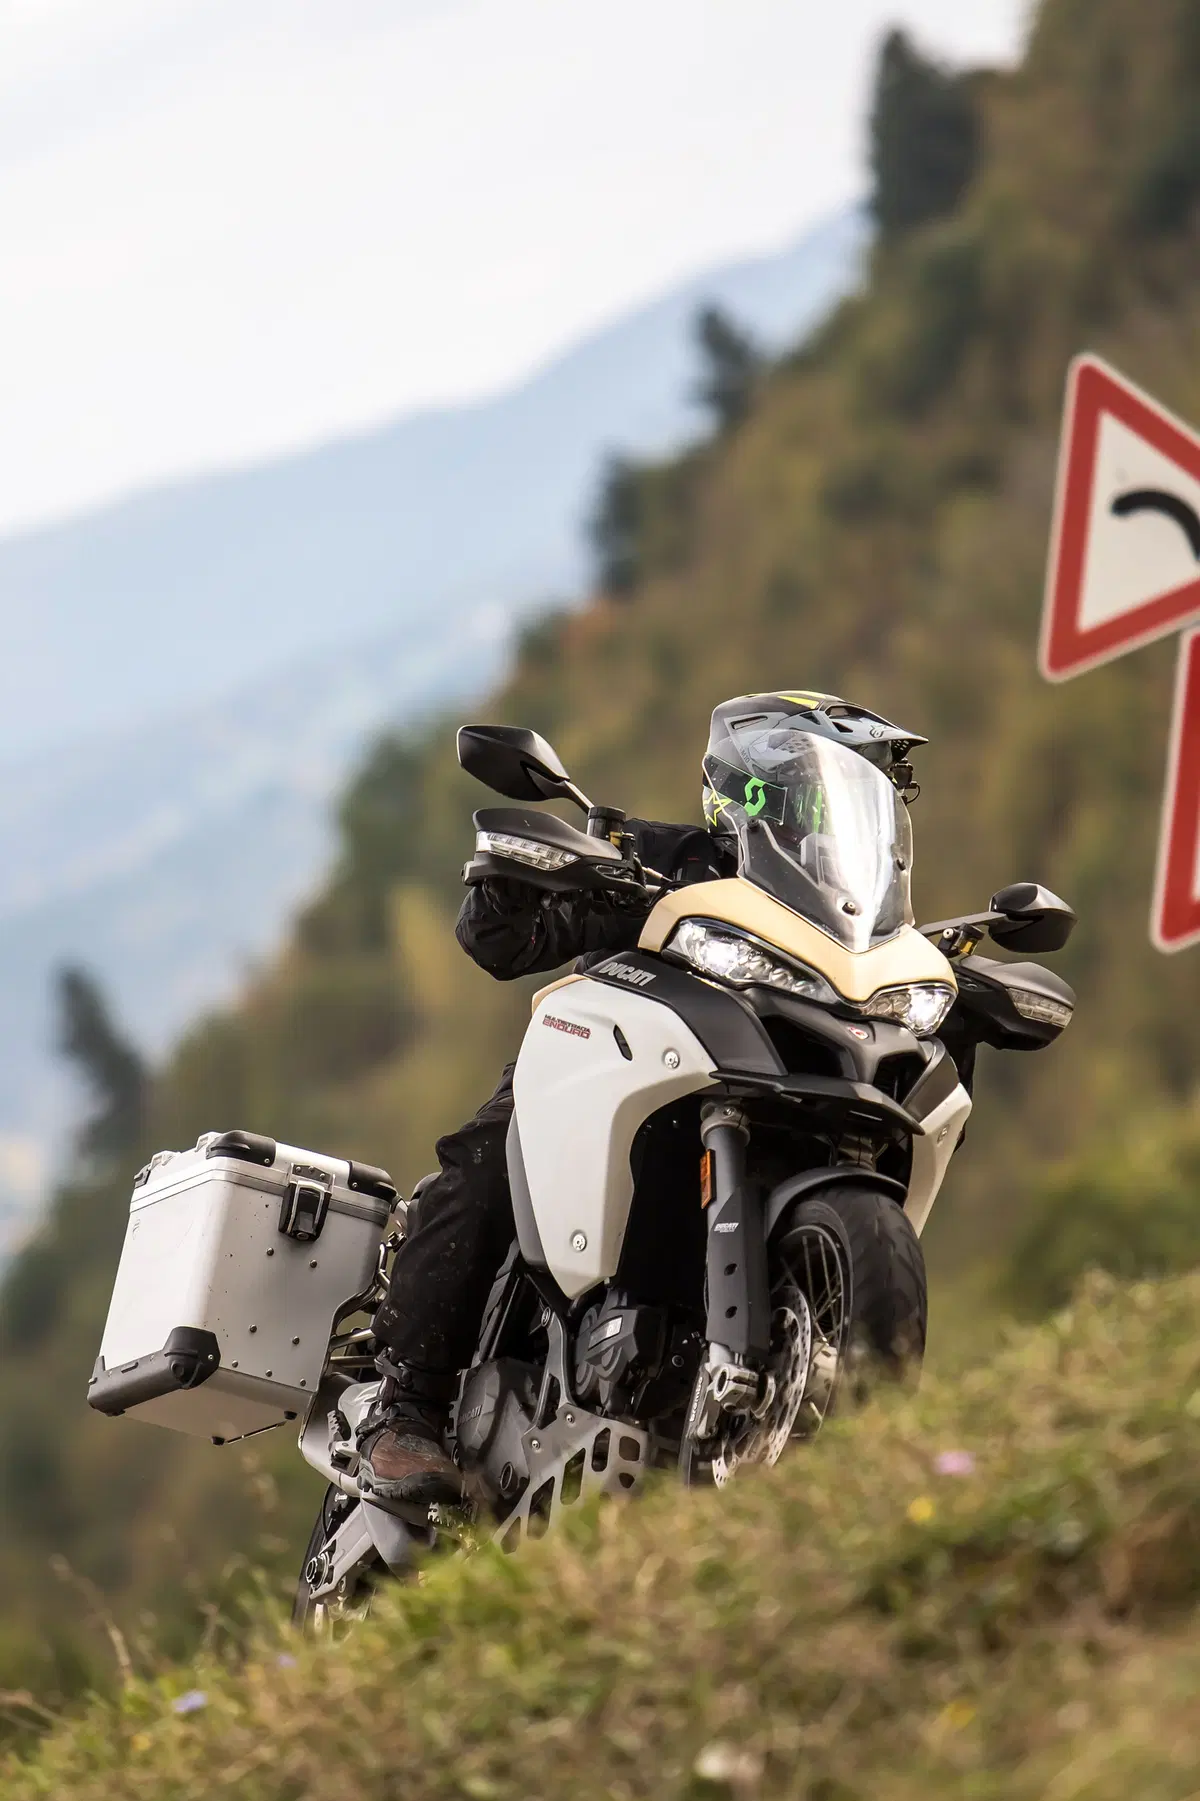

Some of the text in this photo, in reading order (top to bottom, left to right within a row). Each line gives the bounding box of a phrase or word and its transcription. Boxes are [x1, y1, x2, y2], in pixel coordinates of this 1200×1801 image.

[598, 961, 657, 987] DUCATI
[542, 1019, 591, 1040] ENDURO
[689, 1376, 703, 1422] brembo
